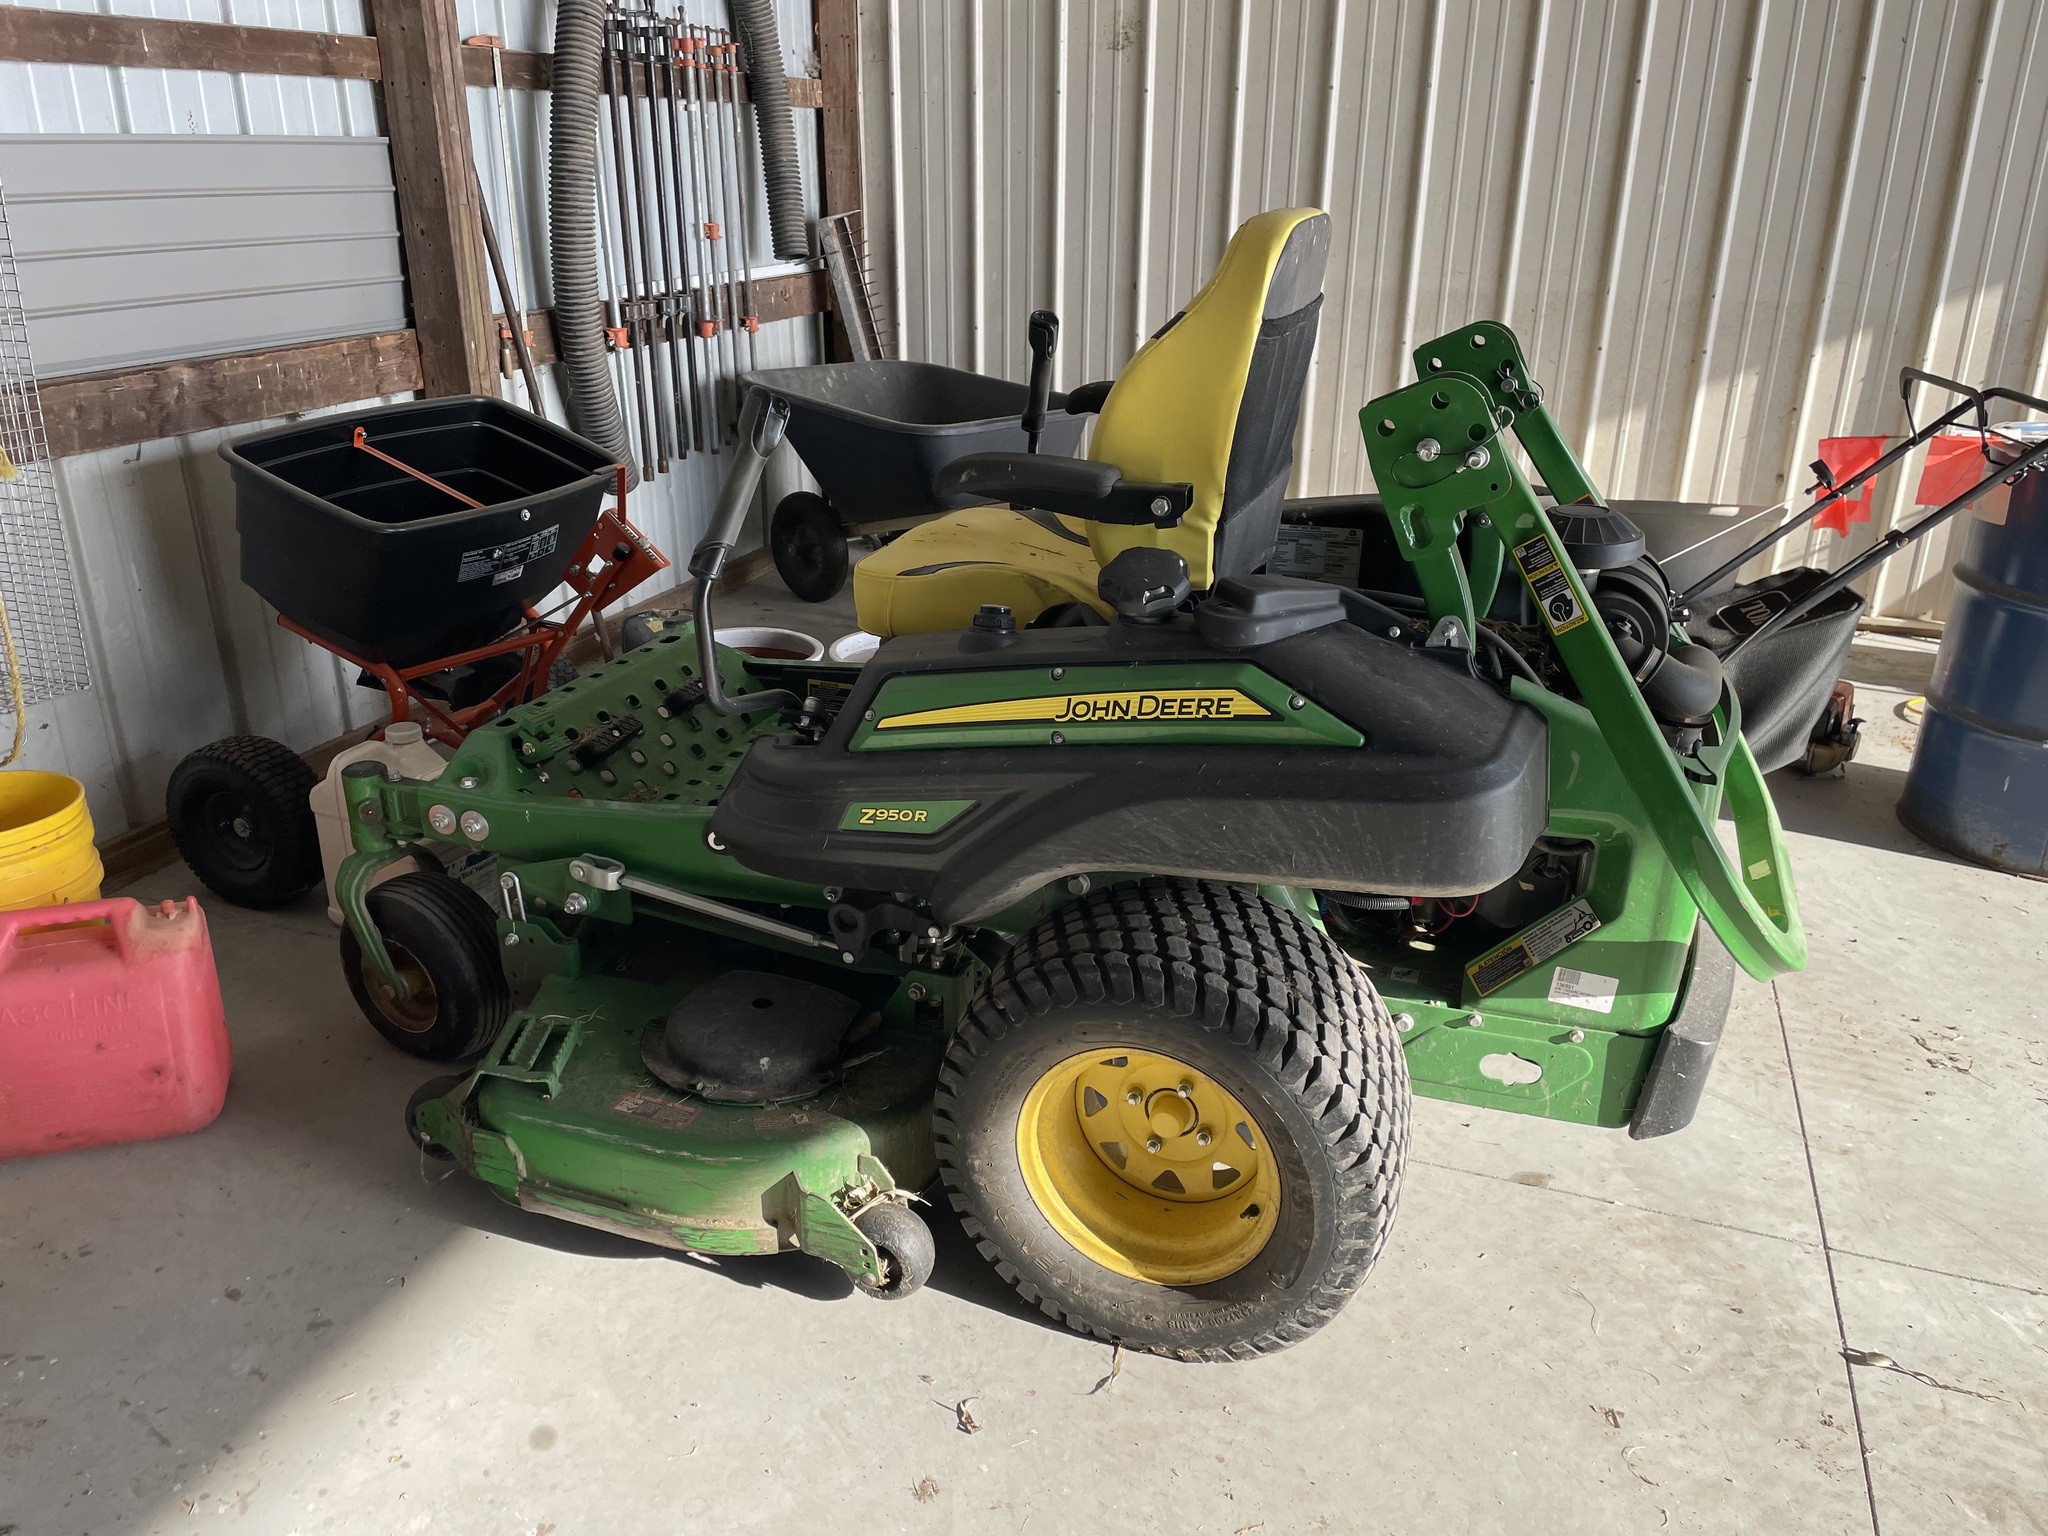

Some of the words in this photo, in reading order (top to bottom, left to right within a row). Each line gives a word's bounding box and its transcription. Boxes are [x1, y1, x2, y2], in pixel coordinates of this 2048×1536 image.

[1556, 618, 1581, 633] CAUTION
[1055, 697, 1131, 719] JOHN
[1137, 695, 1234, 717] DEERE
[859, 808, 928, 824] Z950R
[1483, 945, 1513, 968] ATENCIÓN
[983, 1175, 1096, 1297] KENDA
